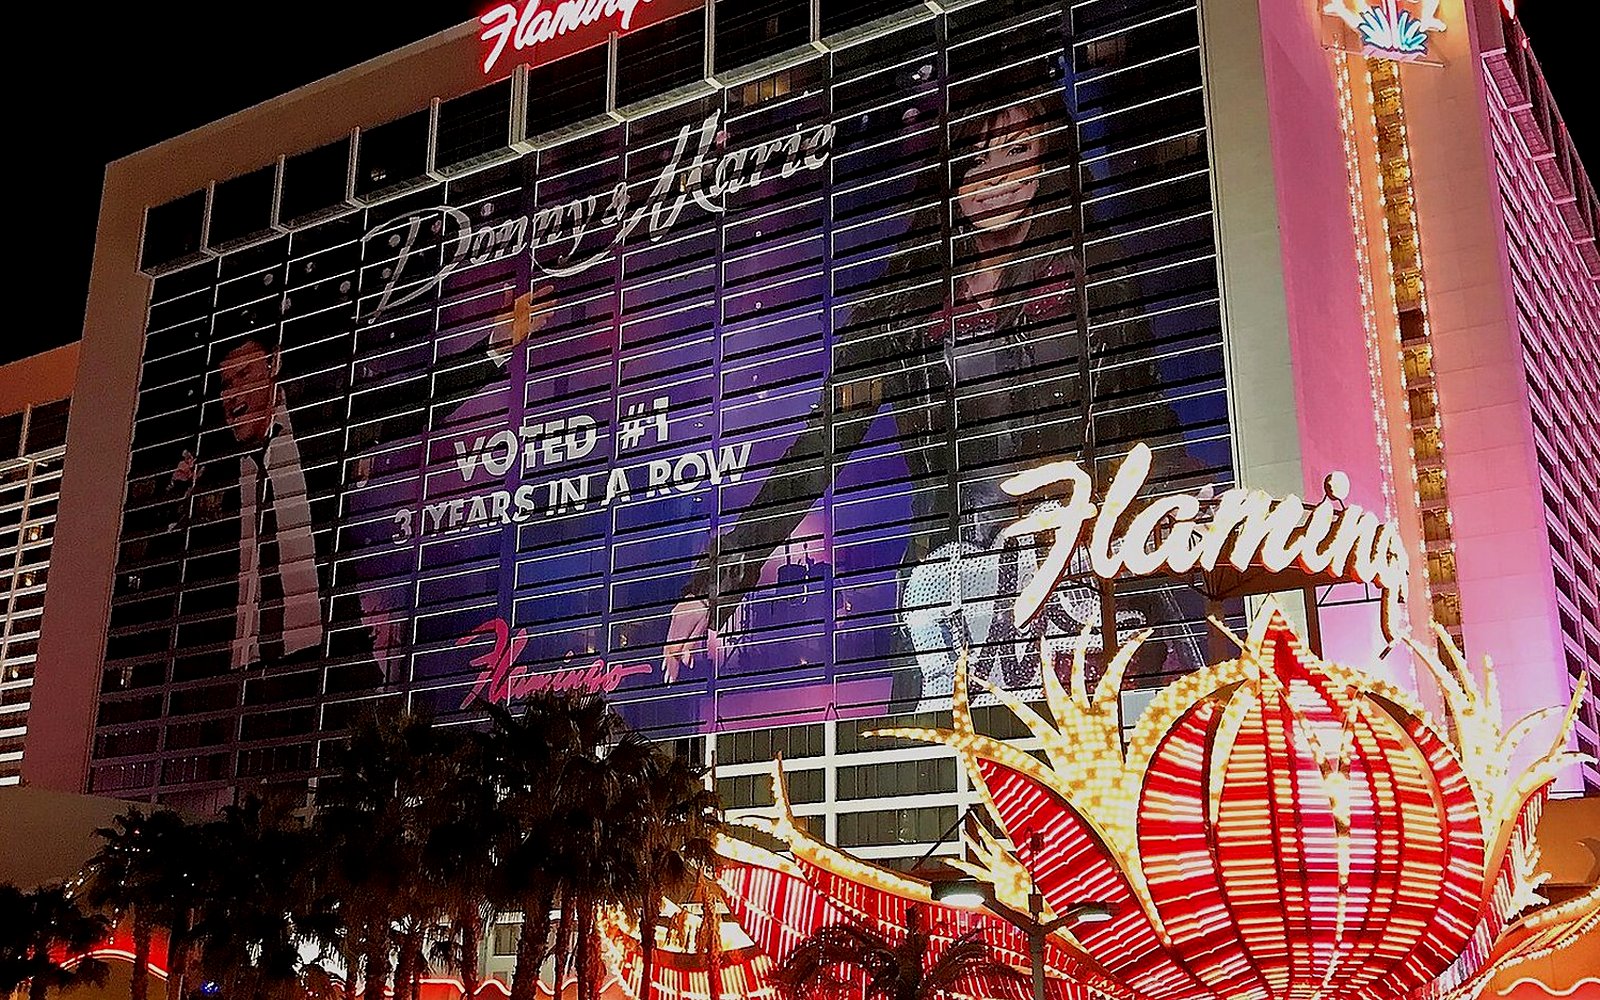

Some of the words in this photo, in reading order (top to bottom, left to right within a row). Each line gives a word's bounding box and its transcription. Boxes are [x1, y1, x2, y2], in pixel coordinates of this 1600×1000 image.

[480, 0, 654, 73] Flaming
[361, 194, 597, 323] Donny
[562, 108, 836, 272] Marie
[454, 415, 598, 481] VOTED
[620, 396, 670, 450] #1
[392, 508, 412, 545] 3
[425, 484, 535, 537] YEARS
[546, 474, 589, 516] IN
[606, 469, 631, 503] A
[647, 443, 752, 498] ROW
[459, 617, 652, 710] Flamingo
